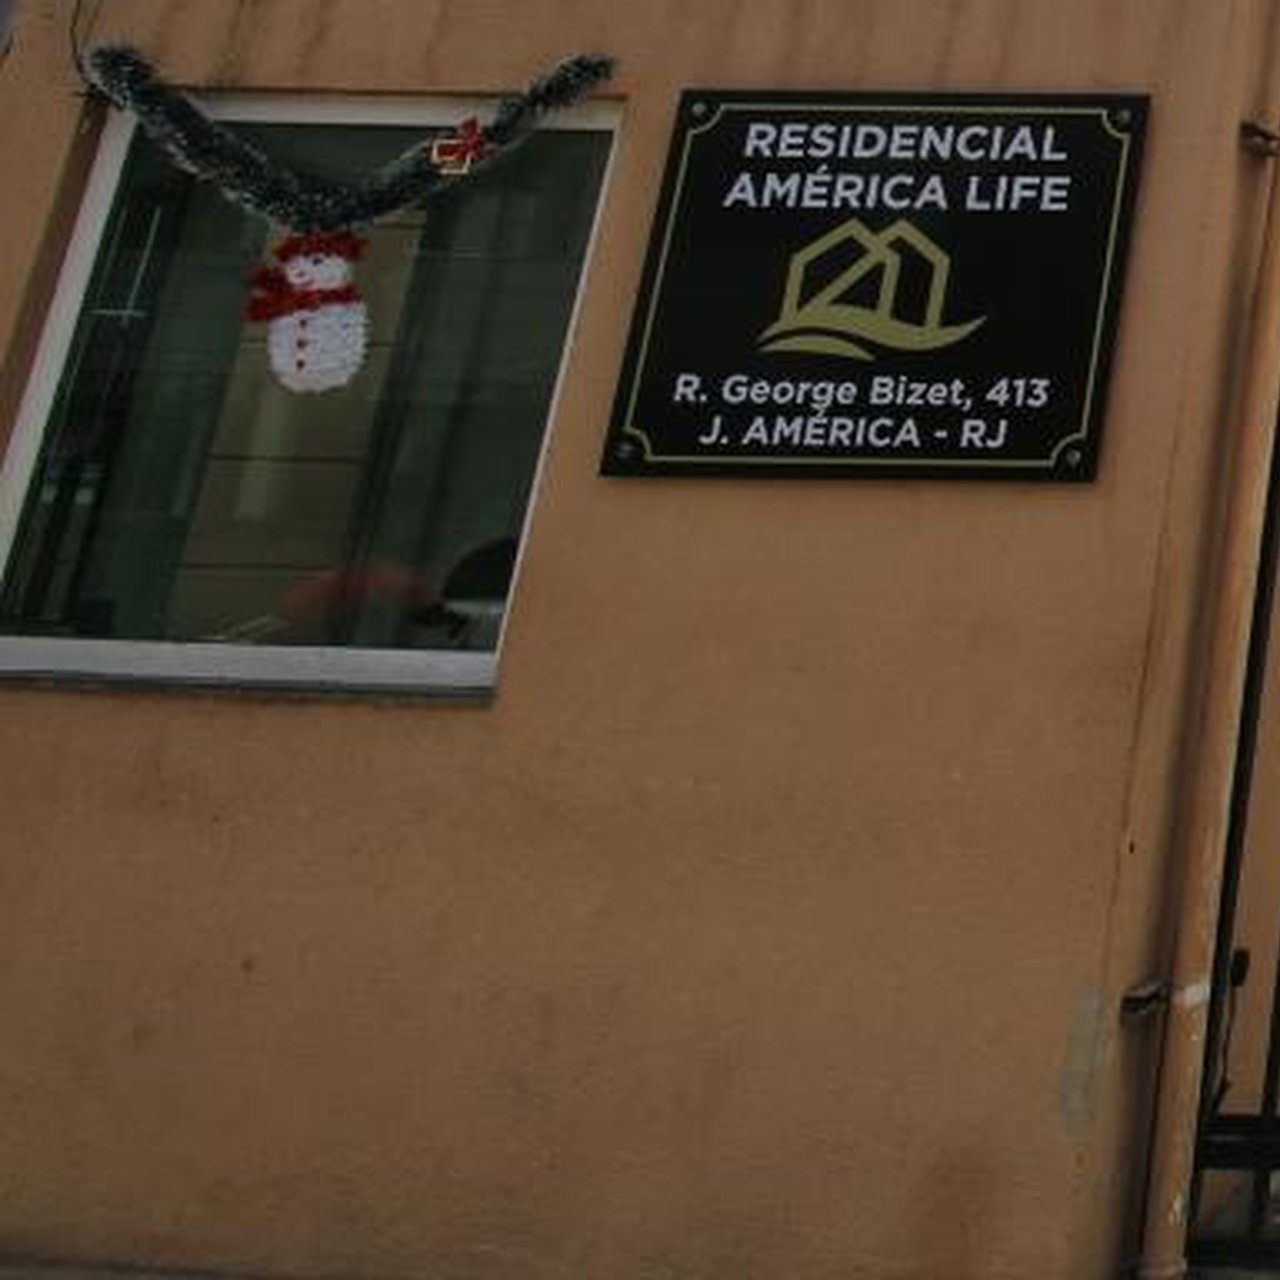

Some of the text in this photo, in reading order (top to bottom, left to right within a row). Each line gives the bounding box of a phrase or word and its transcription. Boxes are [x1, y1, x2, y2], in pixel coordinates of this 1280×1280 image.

[745, 123, 1068, 162] RESIDENCIAL
[723, 165, 1071, 212] AMÉRICA LIFE
[673, 373, 1051, 414] R. George Bizet, 413
[698, 415, 729, 445] J.
[741, 408, 921, 447] AMÉRICA
[959, 418, 1009, 448] RJ
